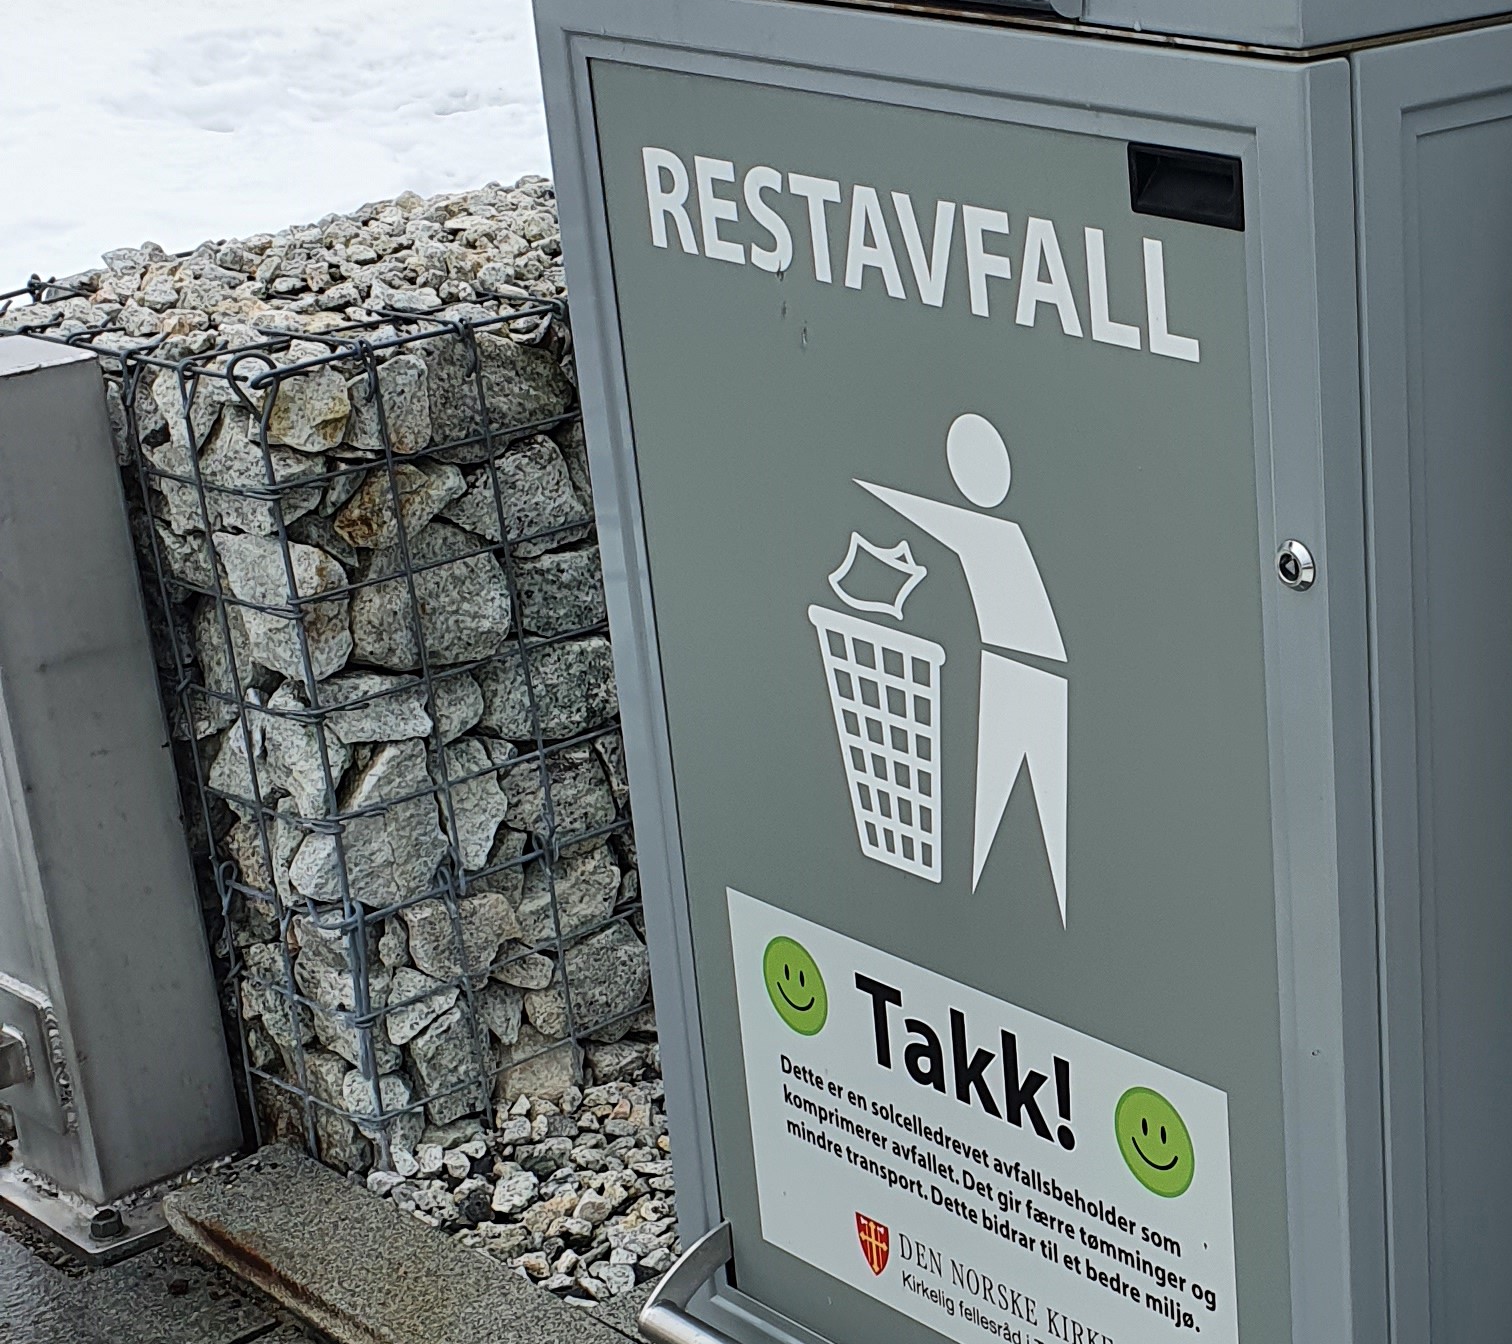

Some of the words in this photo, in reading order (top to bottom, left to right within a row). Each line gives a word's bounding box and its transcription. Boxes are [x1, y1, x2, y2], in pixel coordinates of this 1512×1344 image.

[642, 146, 1200, 363] RESTAVFALL
[780, 1054, 824, 1091] Dette
[827, 1081, 844, 1099] er
[847, 1091, 868, 1111] en
[871, 1101, 990, 1169] solcelledrevet
[993, 1157, 1137, 1236] avfallsbeholder
[1141, 1225, 1182, 1257] som
[854, 972, 1076, 1151] Takk!
[784, 1084, 888, 1150] komprimerer
[891, 1140, 960, 1185] avfallet.
[962, 1169, 994, 1202] Det
[997, 1190, 1023, 1213] gir
[1026, 1199, 1075, 1239] færre
[1079, 1226, 1187, 1292] tømminger
[1191, 1282, 1217, 1312] og
[787, 1119, 843, 1158] mindre
[845, 1146, 929, 1201] transport.
[930, 1184, 978, 1225] Dette
[982, 1208, 1036, 1252] bidrar
[1039, 1236, 1059, 1264] til
[1063, 1253, 1082, 1275] et
[1085, 1258, 1141, 1303] bedre
[1145, 1292, 1201, 1333] miljø.
[899, 1232, 943, 1278] DEN
[950, 1259, 1038, 1326] NORSKE
[902, 1270, 956, 1316] Kirkelig
